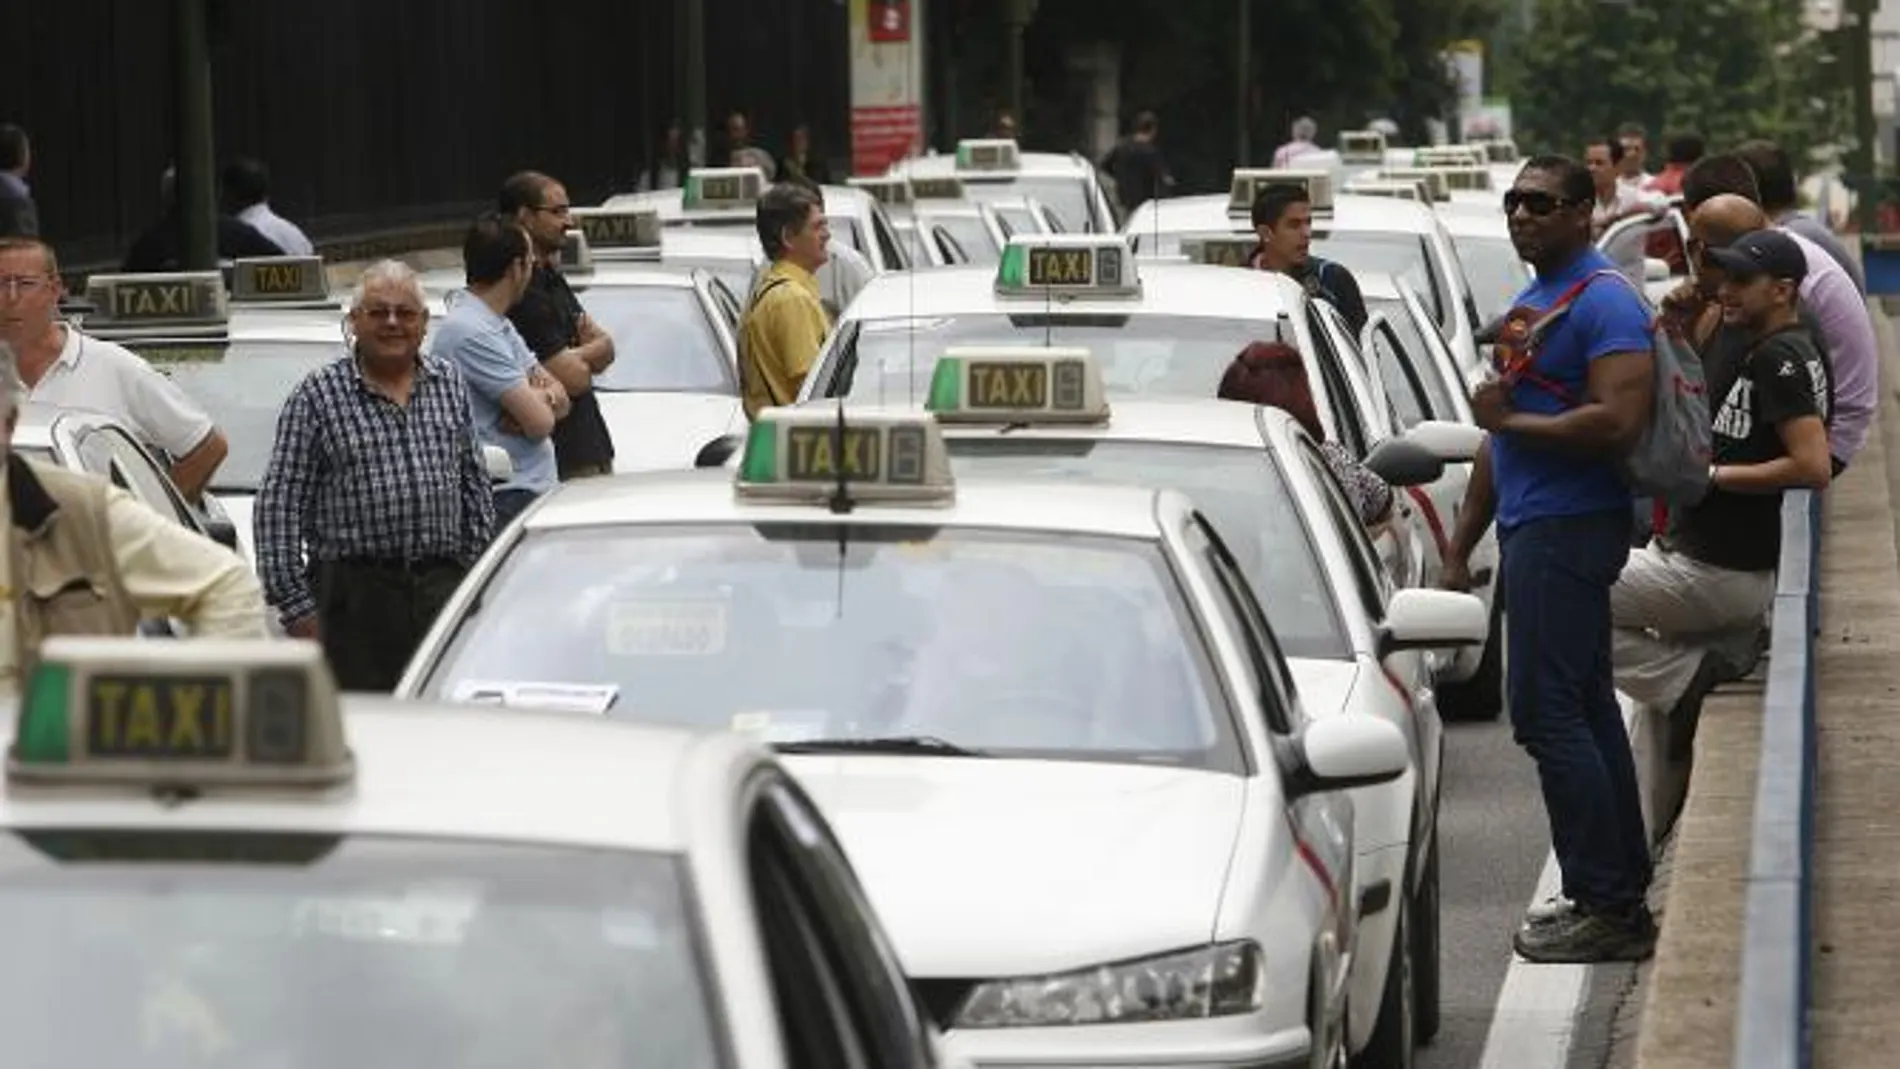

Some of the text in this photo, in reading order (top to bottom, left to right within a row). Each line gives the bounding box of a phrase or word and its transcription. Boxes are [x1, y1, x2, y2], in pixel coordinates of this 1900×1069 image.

[581, 218, 635, 239] TAXI
[255, 266, 303, 291] TAXI
[1031, 251, 1089, 281] TAXI
[118, 285, 189, 315] TAXI
[971, 368, 1045, 404] TAXI
[791, 431, 876, 474] TAXI
[95, 683, 231, 747] TAXI
